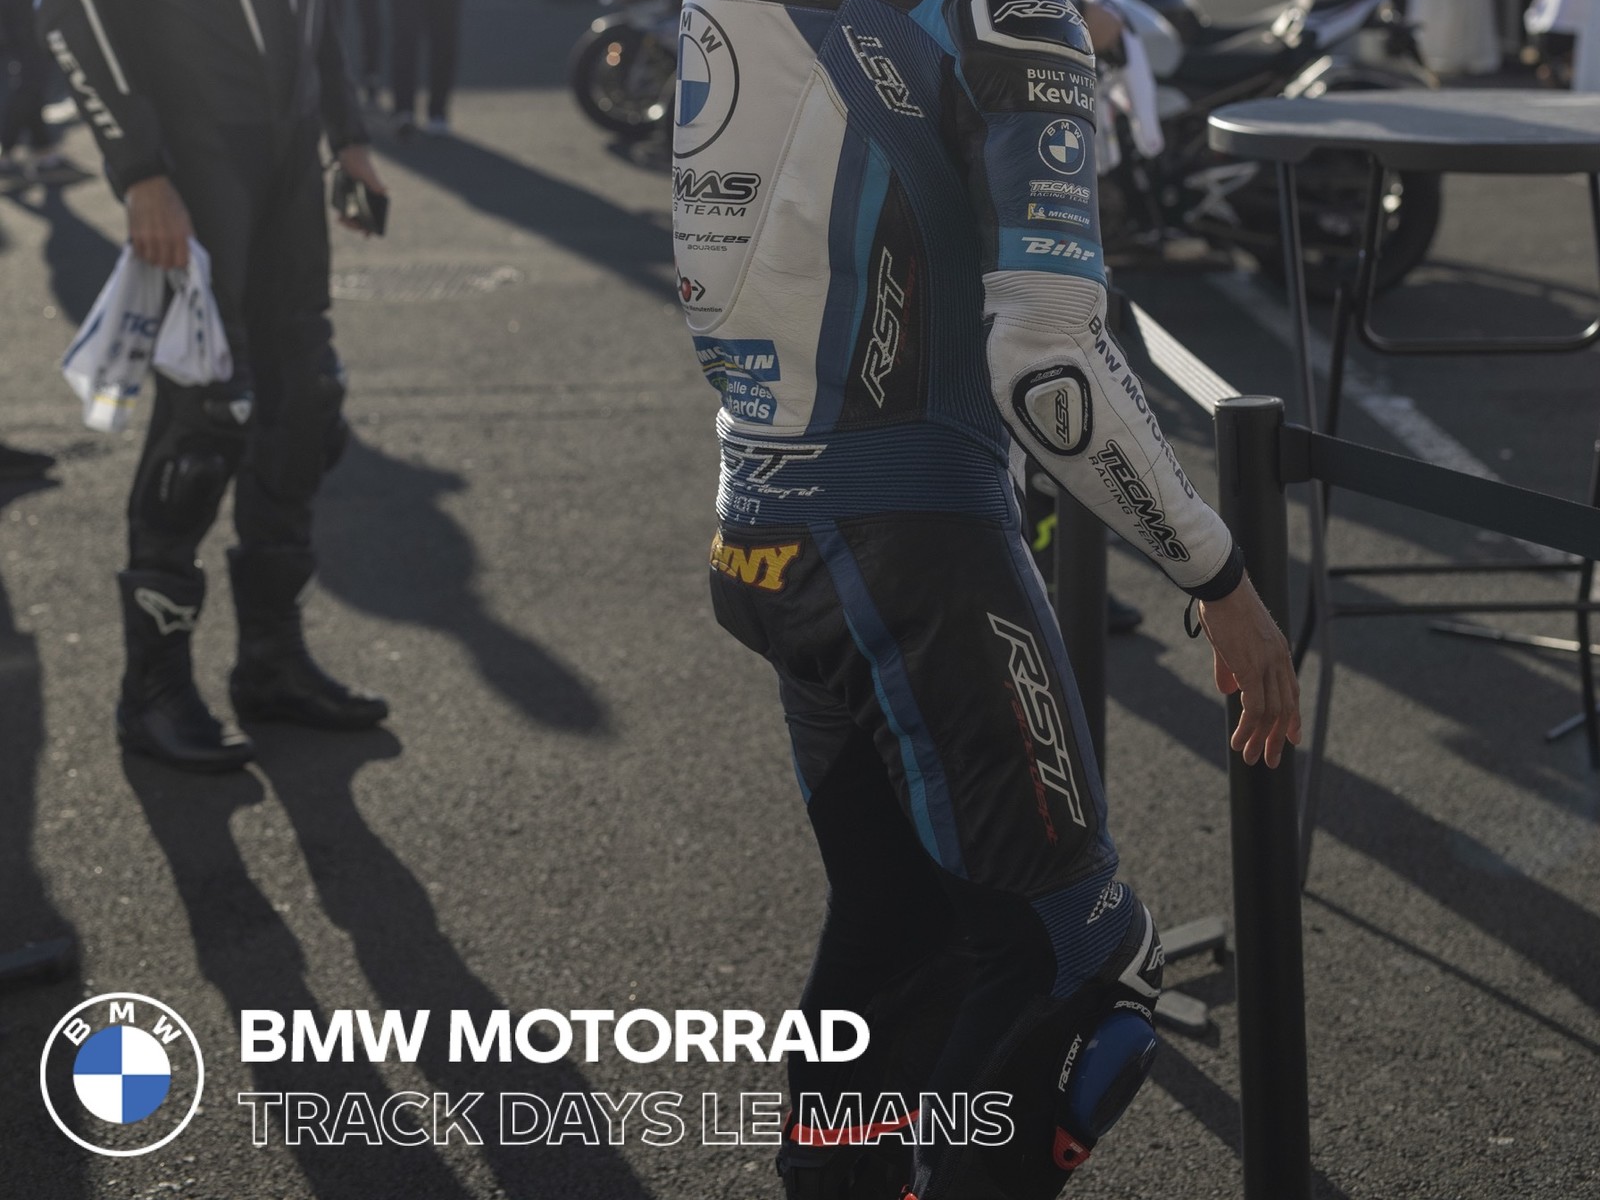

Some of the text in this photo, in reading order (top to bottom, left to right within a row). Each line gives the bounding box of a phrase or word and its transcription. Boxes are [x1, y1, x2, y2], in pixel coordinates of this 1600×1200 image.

[681, 11, 723, 53] MW
[1027, 69, 1095, 89] BUILT WITH
[1047, 122, 1082, 139] BMW
[673, 166, 761, 205] MAS
[1029, 180, 1091, 199] TECMAS
[684, 204, 746, 217] TEAM
[1048, 210, 1090, 224] MICHELIN
[674, 231, 752, 244] services
[1022, 236, 1096, 261] Bihr
[861, 246, 905, 409] RST
[1089, 316, 1121, 373] BMW
[727, 381, 772, 399] elle des
[1055, 388, 1070, 444] RST
[1088, 456, 1164, 559] RACING TEAM
[1099, 439, 1190, 562] TECMAS
[987, 612, 1086, 828] RST
